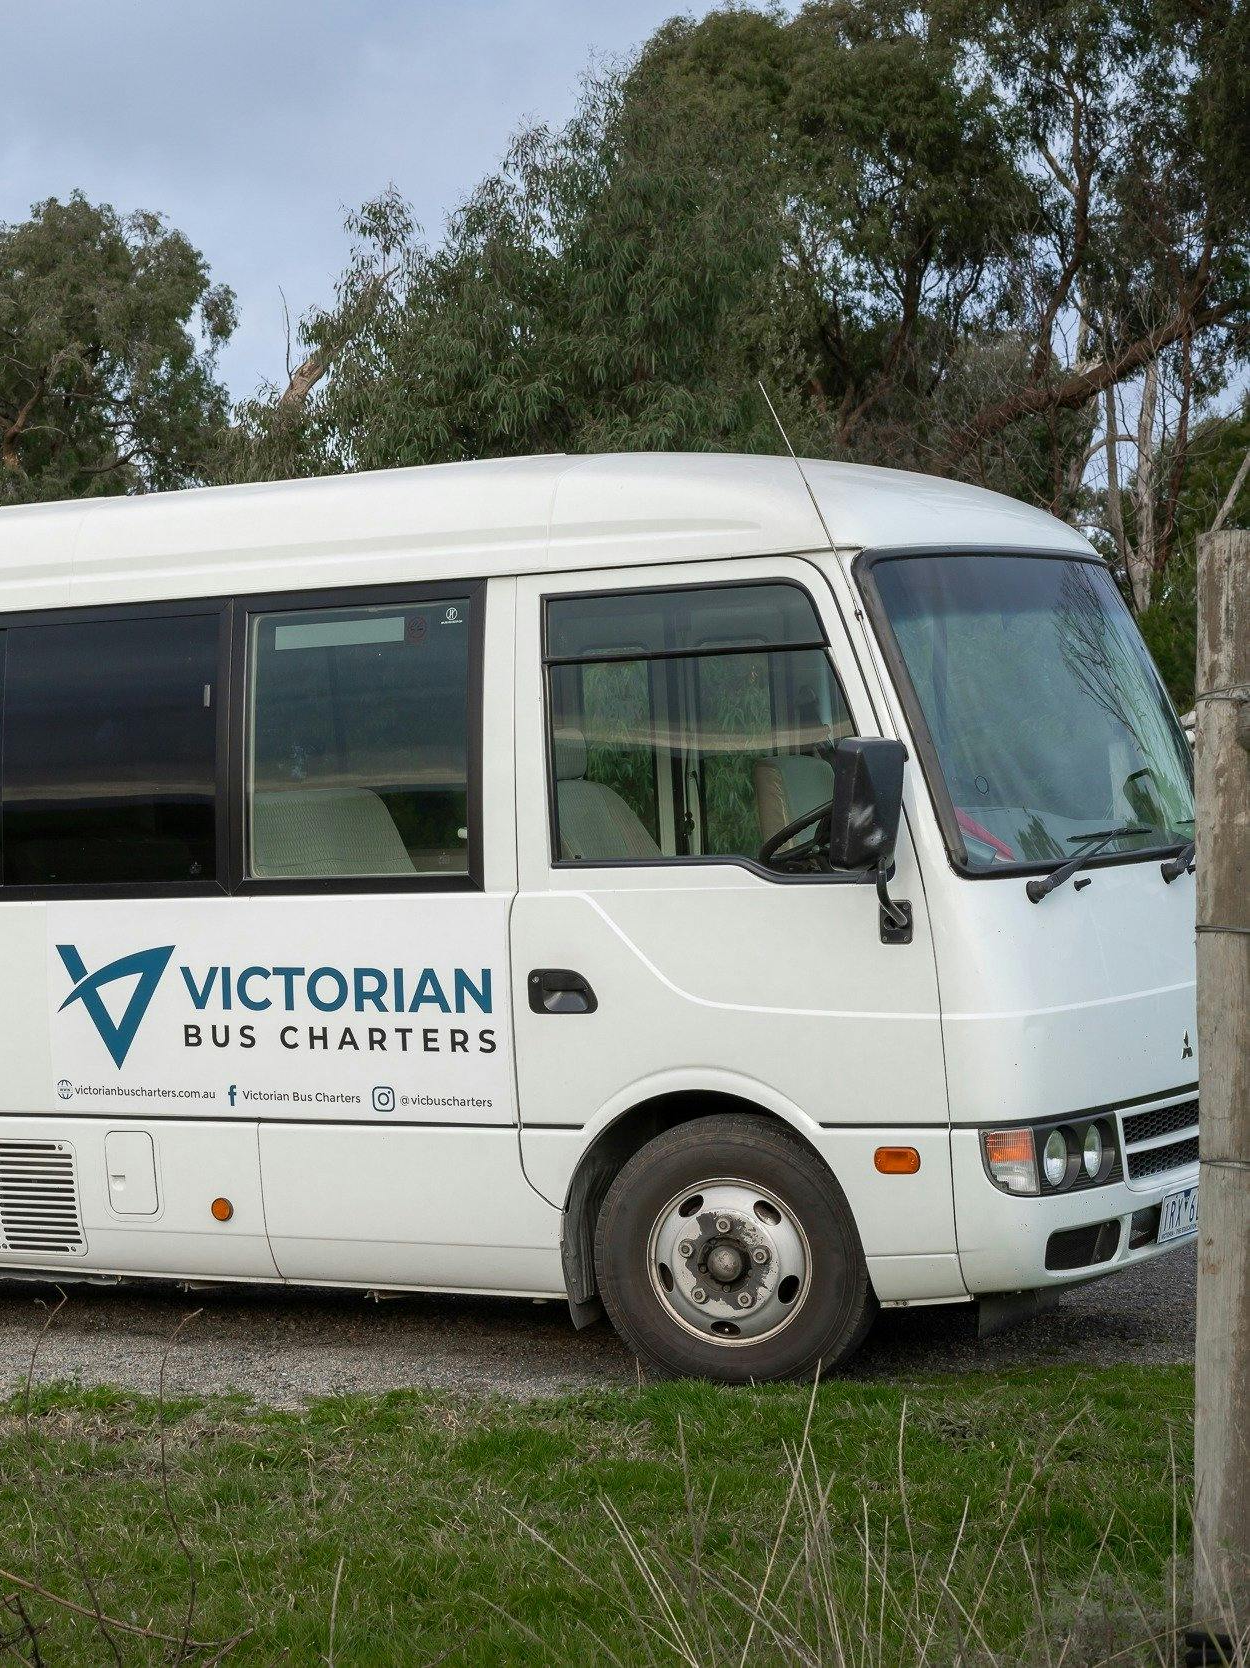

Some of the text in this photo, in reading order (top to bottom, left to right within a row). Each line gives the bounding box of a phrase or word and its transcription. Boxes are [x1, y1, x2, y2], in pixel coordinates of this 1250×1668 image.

[180, 966, 493, 1014] VICTORIAN
[184, 1024, 497, 1054] BUS CHARTERS
[74, 1085, 216, 1099] victorianbuscharters.com.au
[242, 1090, 361, 1104] Victorian Bus Charters
[400, 1095, 493, 1108] @vicbuscharters
